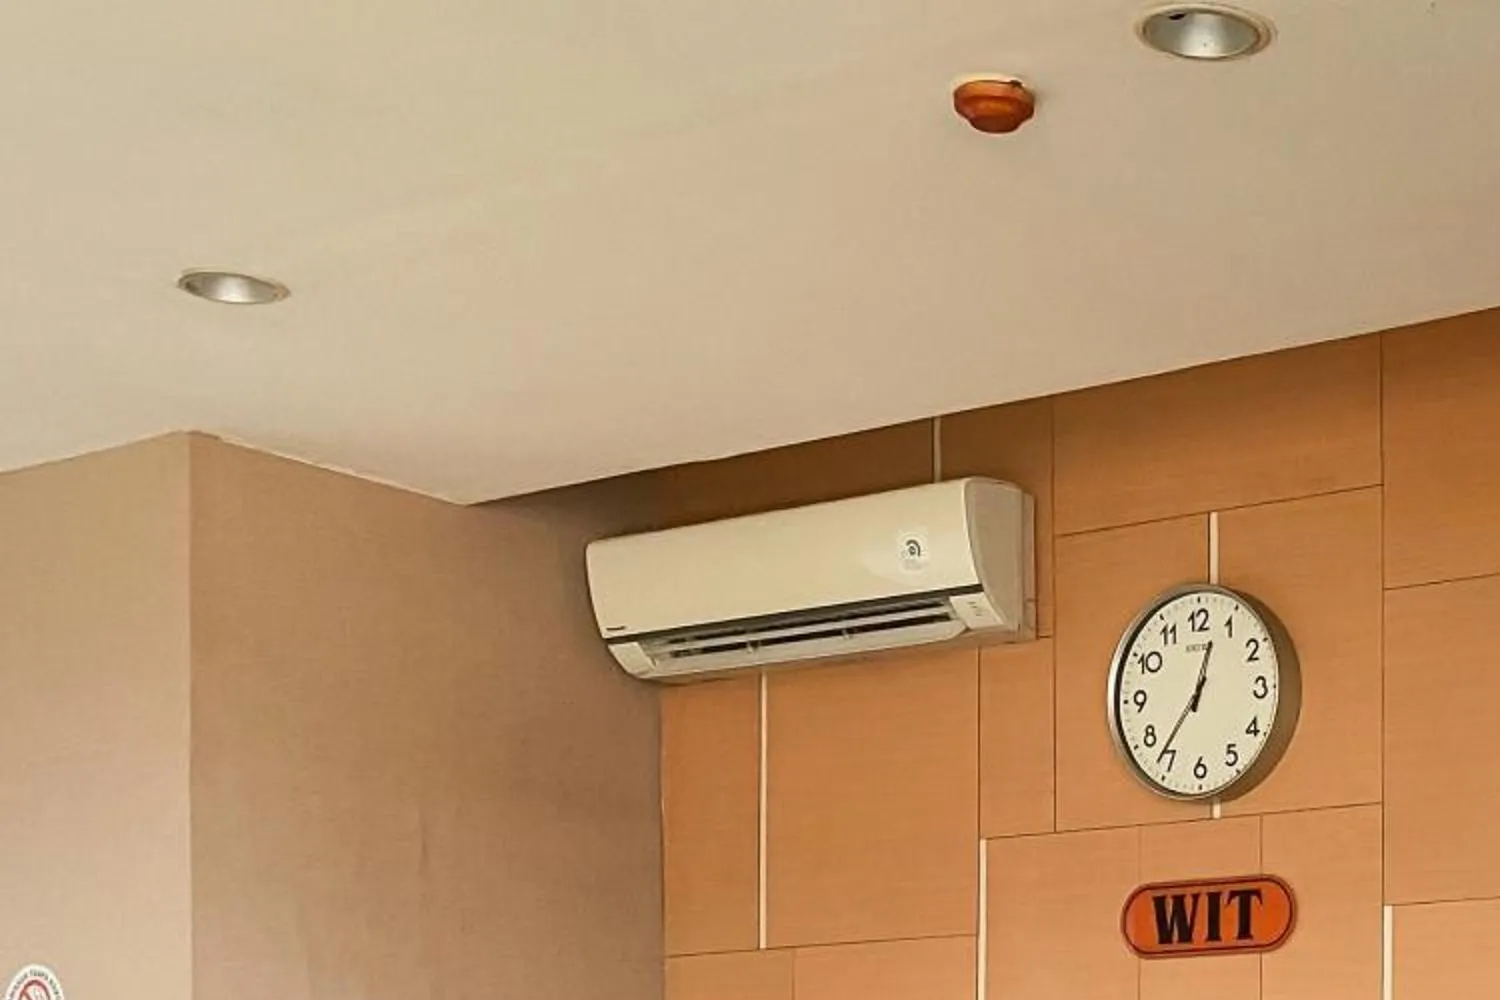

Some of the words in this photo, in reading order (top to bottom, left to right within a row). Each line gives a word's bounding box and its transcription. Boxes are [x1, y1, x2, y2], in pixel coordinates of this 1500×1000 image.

[1187, 608, 1210, 633] 12
[1224, 614, 1233, 638] 1
[1160, 623, 1178, 645] 11
[1245, 638, 1260, 662] 2
[1137, 651, 1163, 674] 10
[1252, 675, 1268, 699] 3
[1133, 689, 1147, 713] 9
[1143, 724, 1157, 747] 8
[1245, 715, 1260, 737] 4
[1162, 749, 1177, 772] 7
[1224, 743, 1239, 767] 5
[1193, 756, 1207, 779] 6
[1152, 889, 1264, 944] WIT
